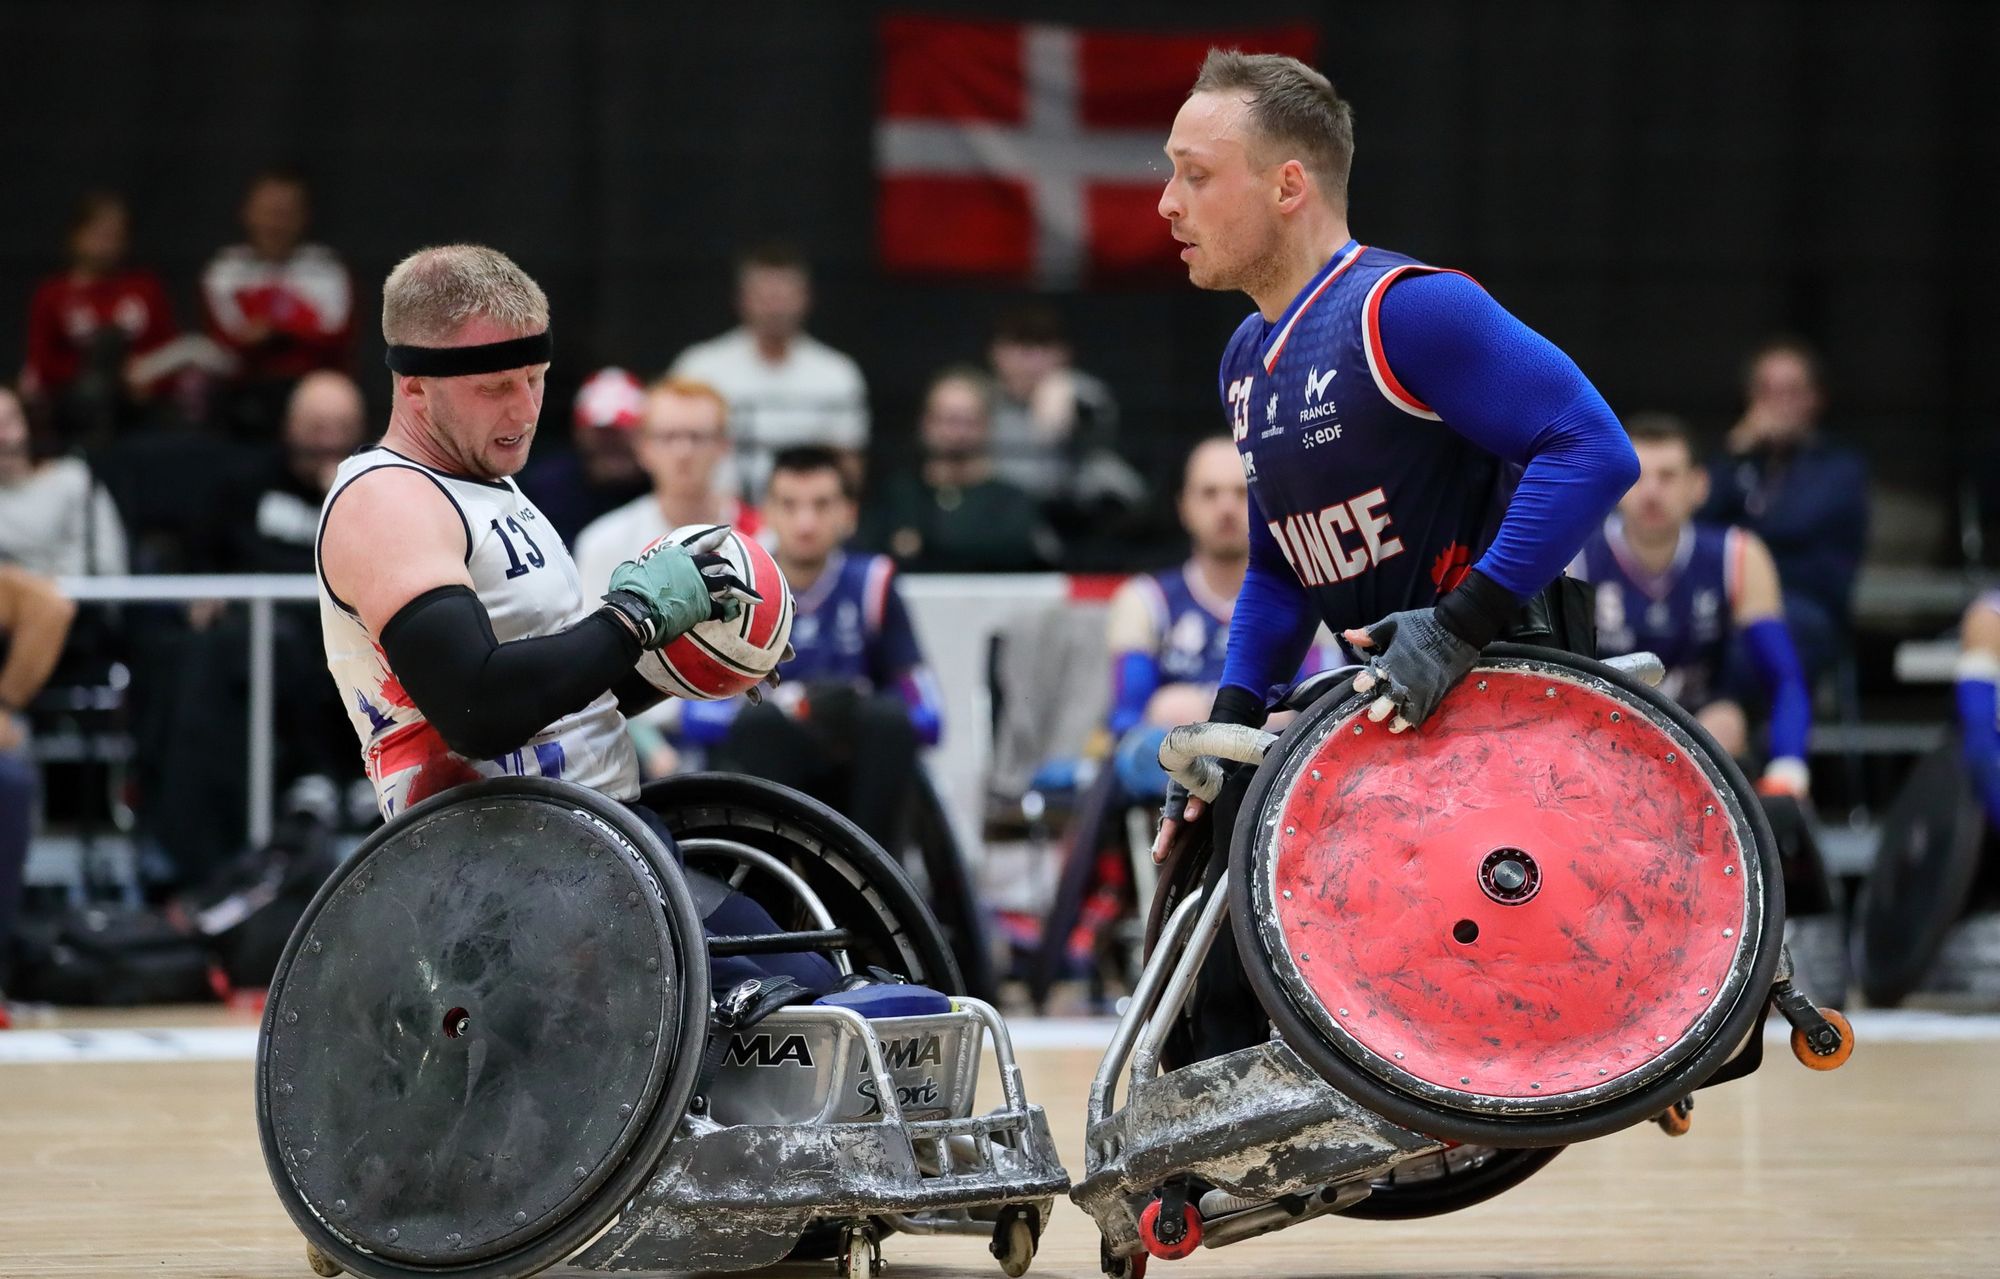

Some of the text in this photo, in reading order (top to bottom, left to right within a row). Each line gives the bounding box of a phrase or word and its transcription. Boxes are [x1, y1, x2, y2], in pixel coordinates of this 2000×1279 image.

[1300, 401, 1337, 423] FRANCE
[490, 514, 546, 580] 13
[713, 1033, 816, 1068] MA
